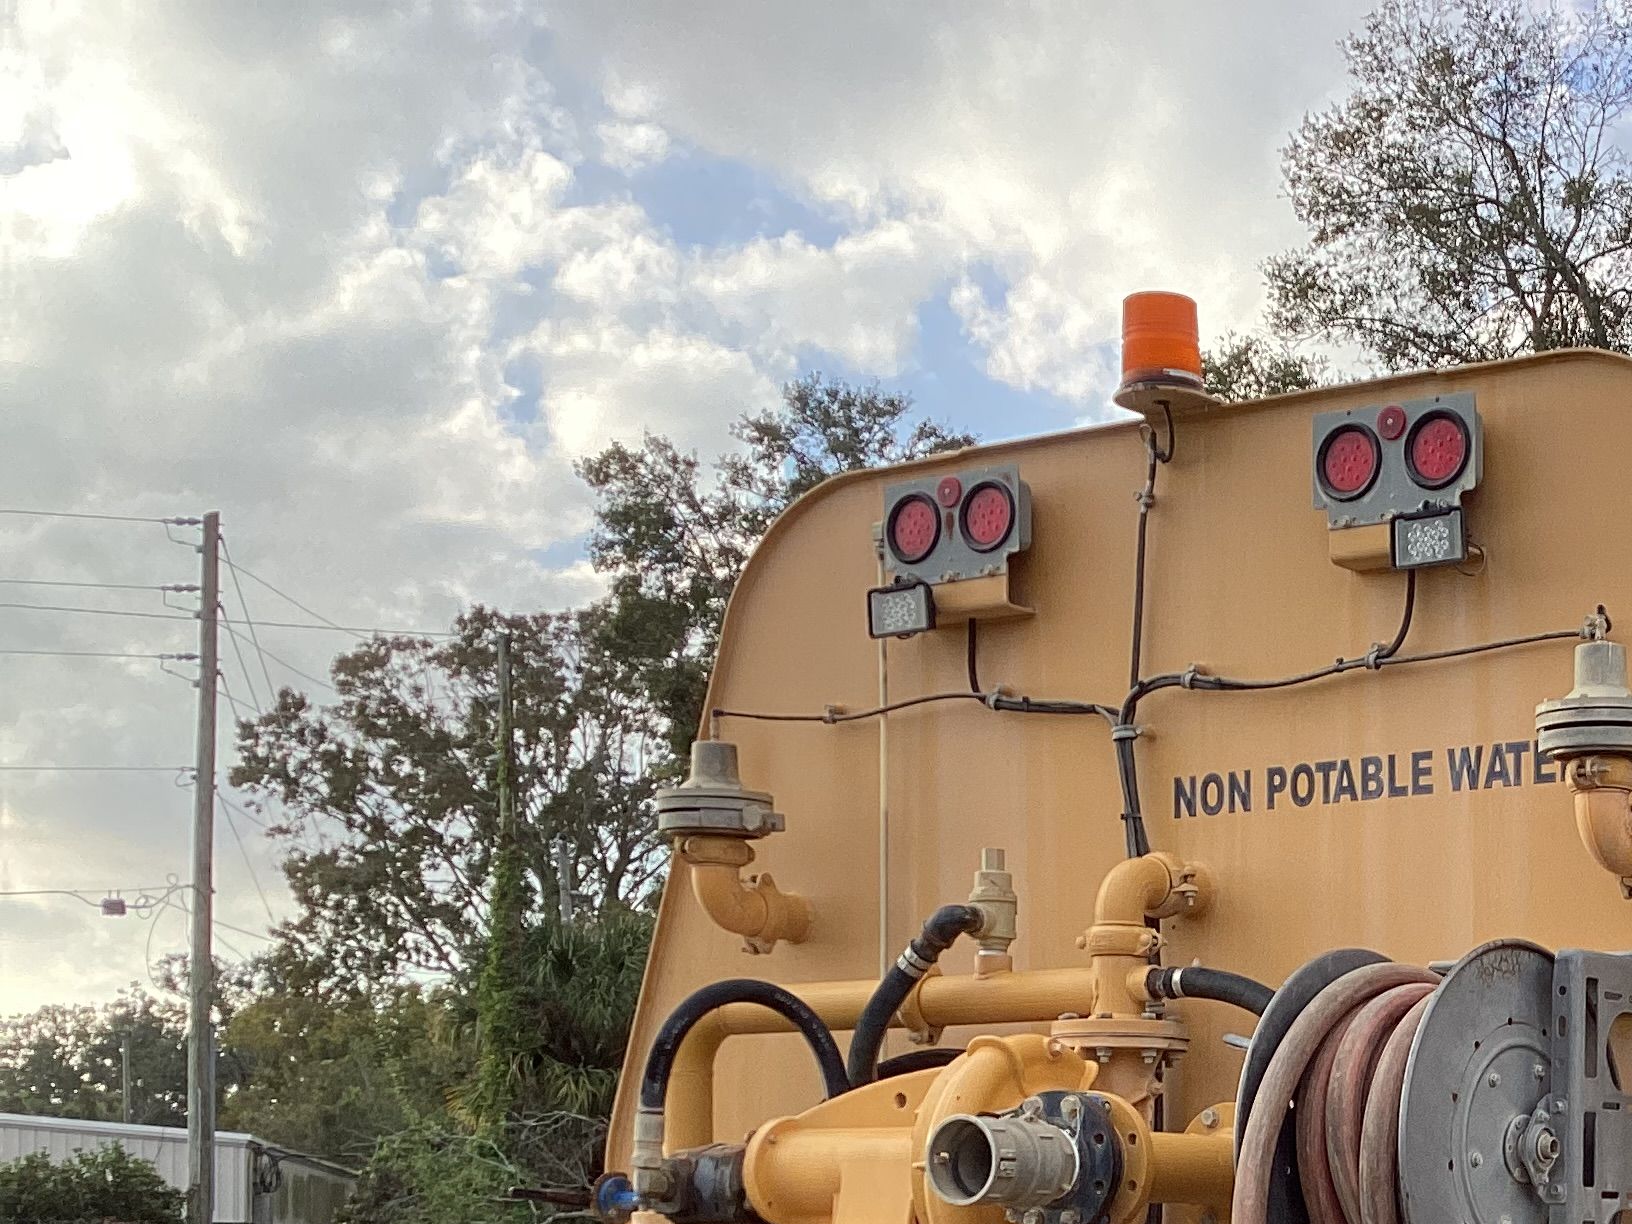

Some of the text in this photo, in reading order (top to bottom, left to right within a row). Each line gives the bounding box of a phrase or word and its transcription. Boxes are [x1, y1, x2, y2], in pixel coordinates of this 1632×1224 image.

[1173, 739, 1567, 819] NON POTABLE WATE
